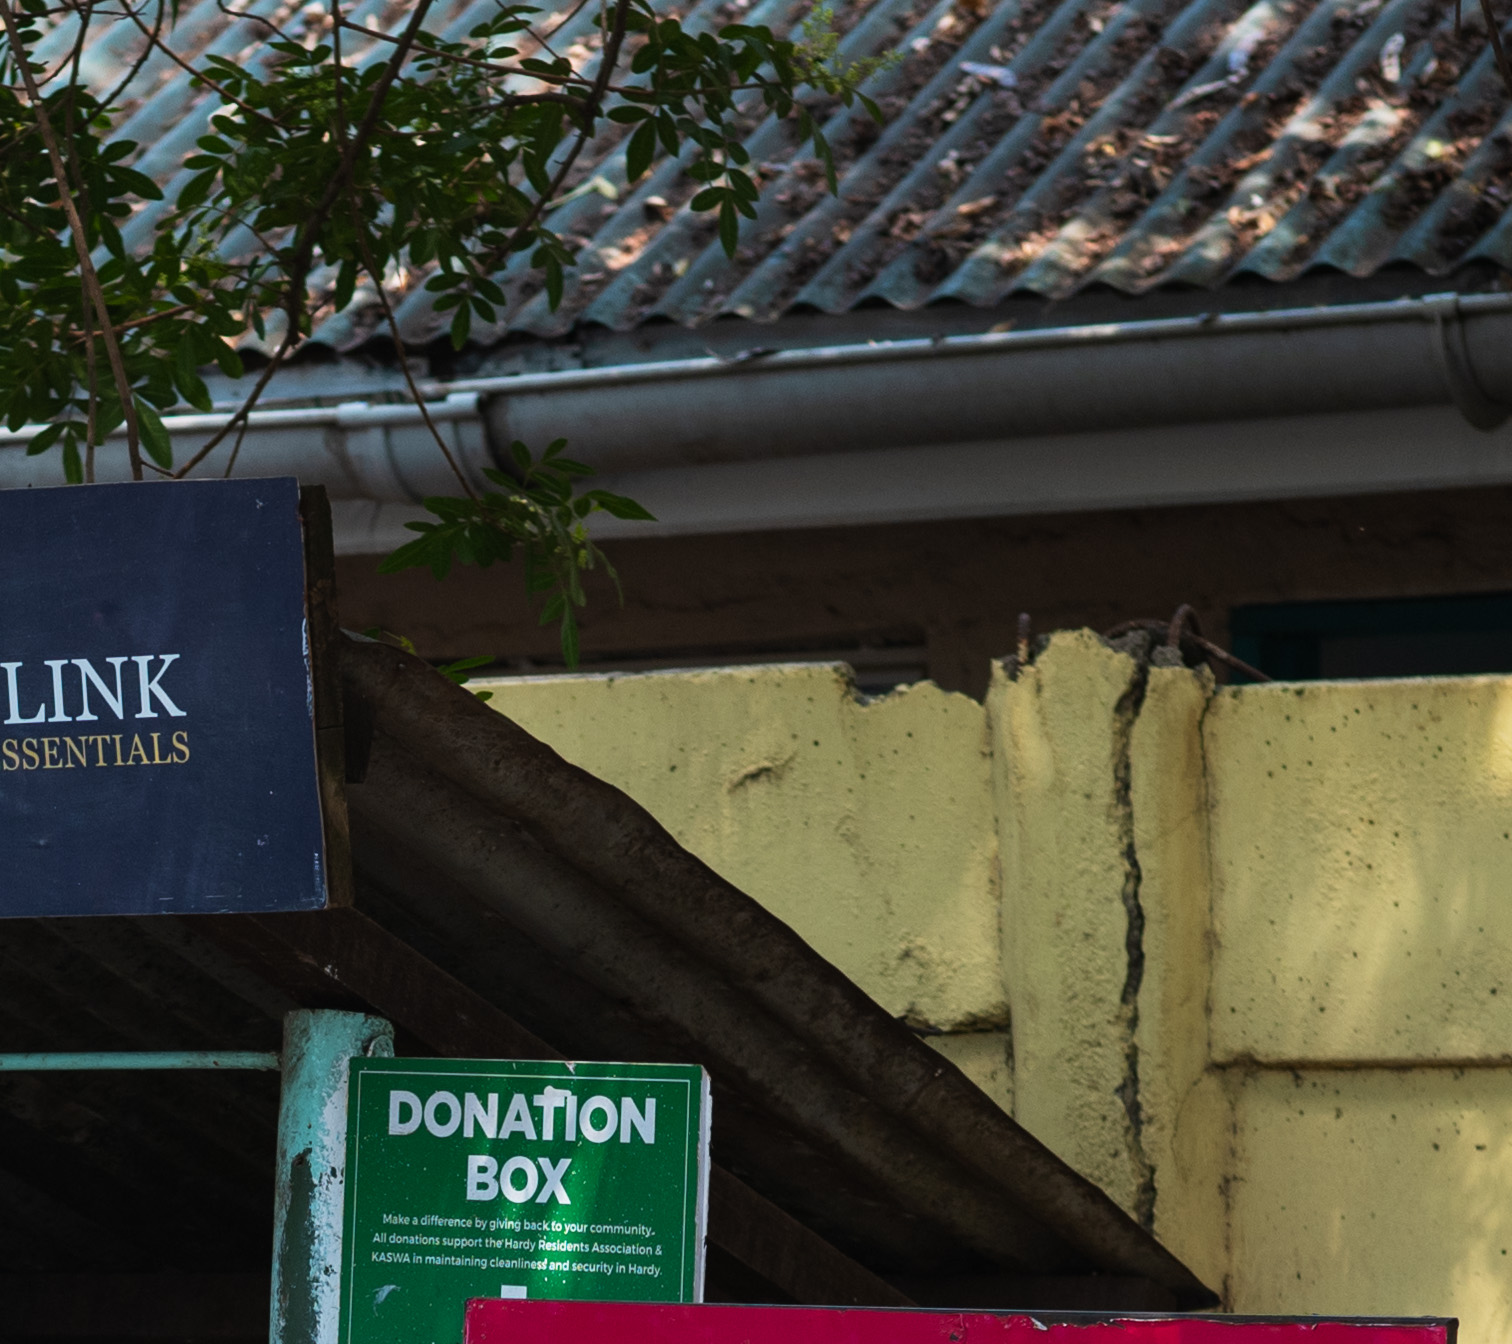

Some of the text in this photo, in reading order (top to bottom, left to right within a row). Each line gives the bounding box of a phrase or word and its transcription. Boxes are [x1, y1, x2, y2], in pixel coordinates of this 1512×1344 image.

[0, 654, 186, 724] LINK
[388, 1086, 656, 1144] DONATION
[466, 1154, 572, 1204] BOX
[383, 1213, 655, 1237] Make a difference by giving back to your community.
